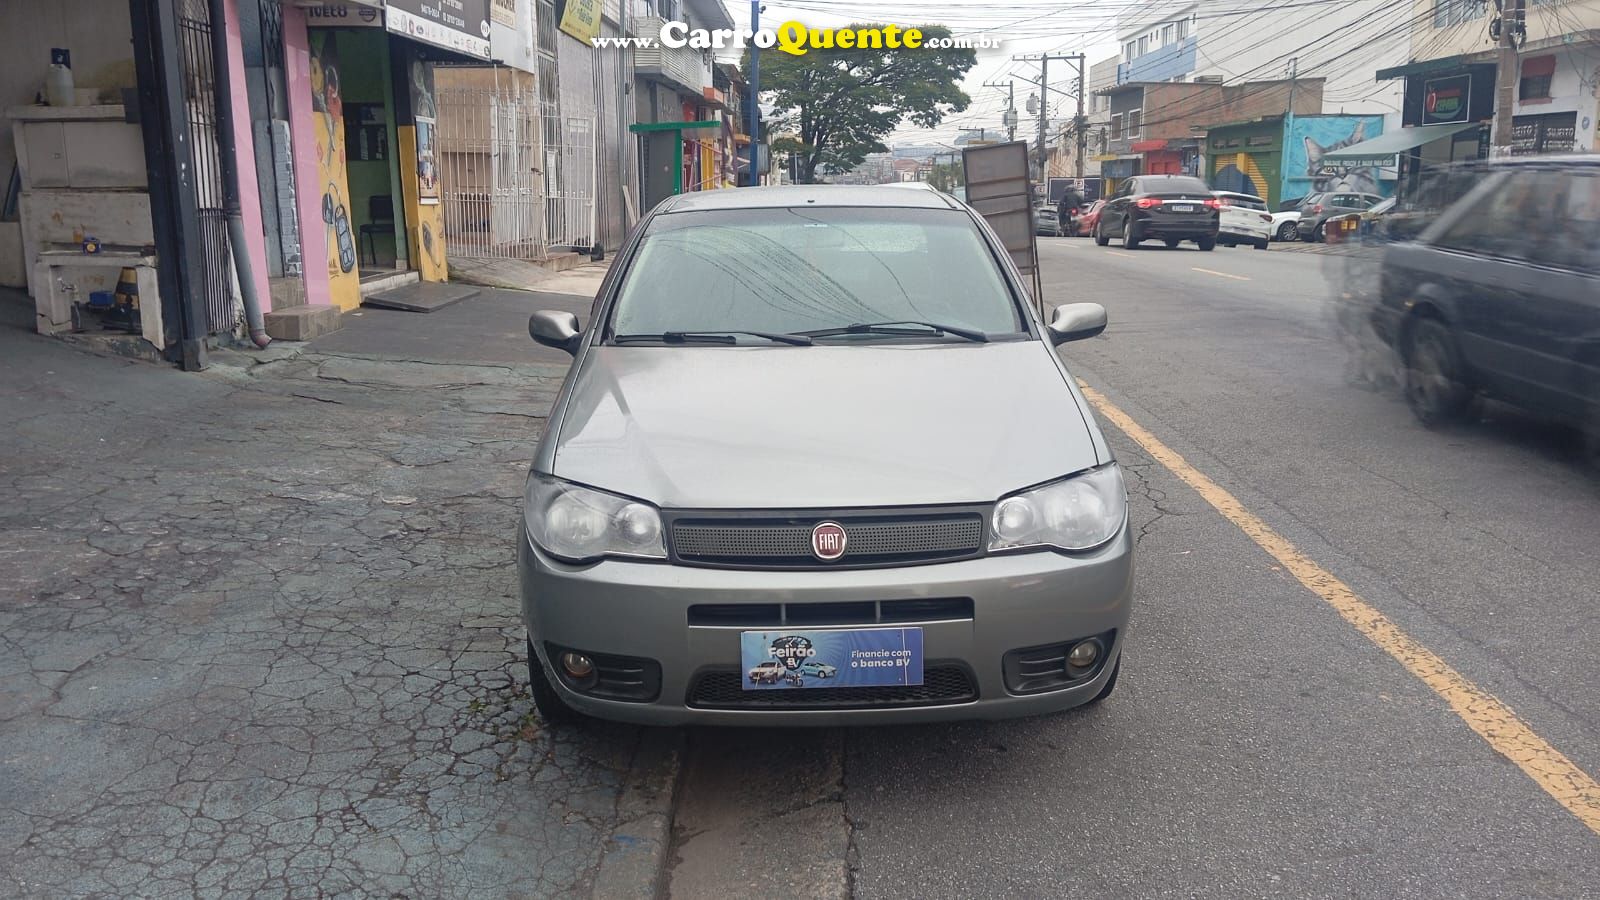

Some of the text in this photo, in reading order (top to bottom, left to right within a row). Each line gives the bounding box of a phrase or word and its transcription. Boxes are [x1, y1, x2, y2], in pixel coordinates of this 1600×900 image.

[819, 533, 840, 550] FIAT
[768, 644, 816, 658] Feirão
[851, 649, 889, 658] Financie
[859, 657, 894, 667] banco
[895, 658, 910, 667] BV
